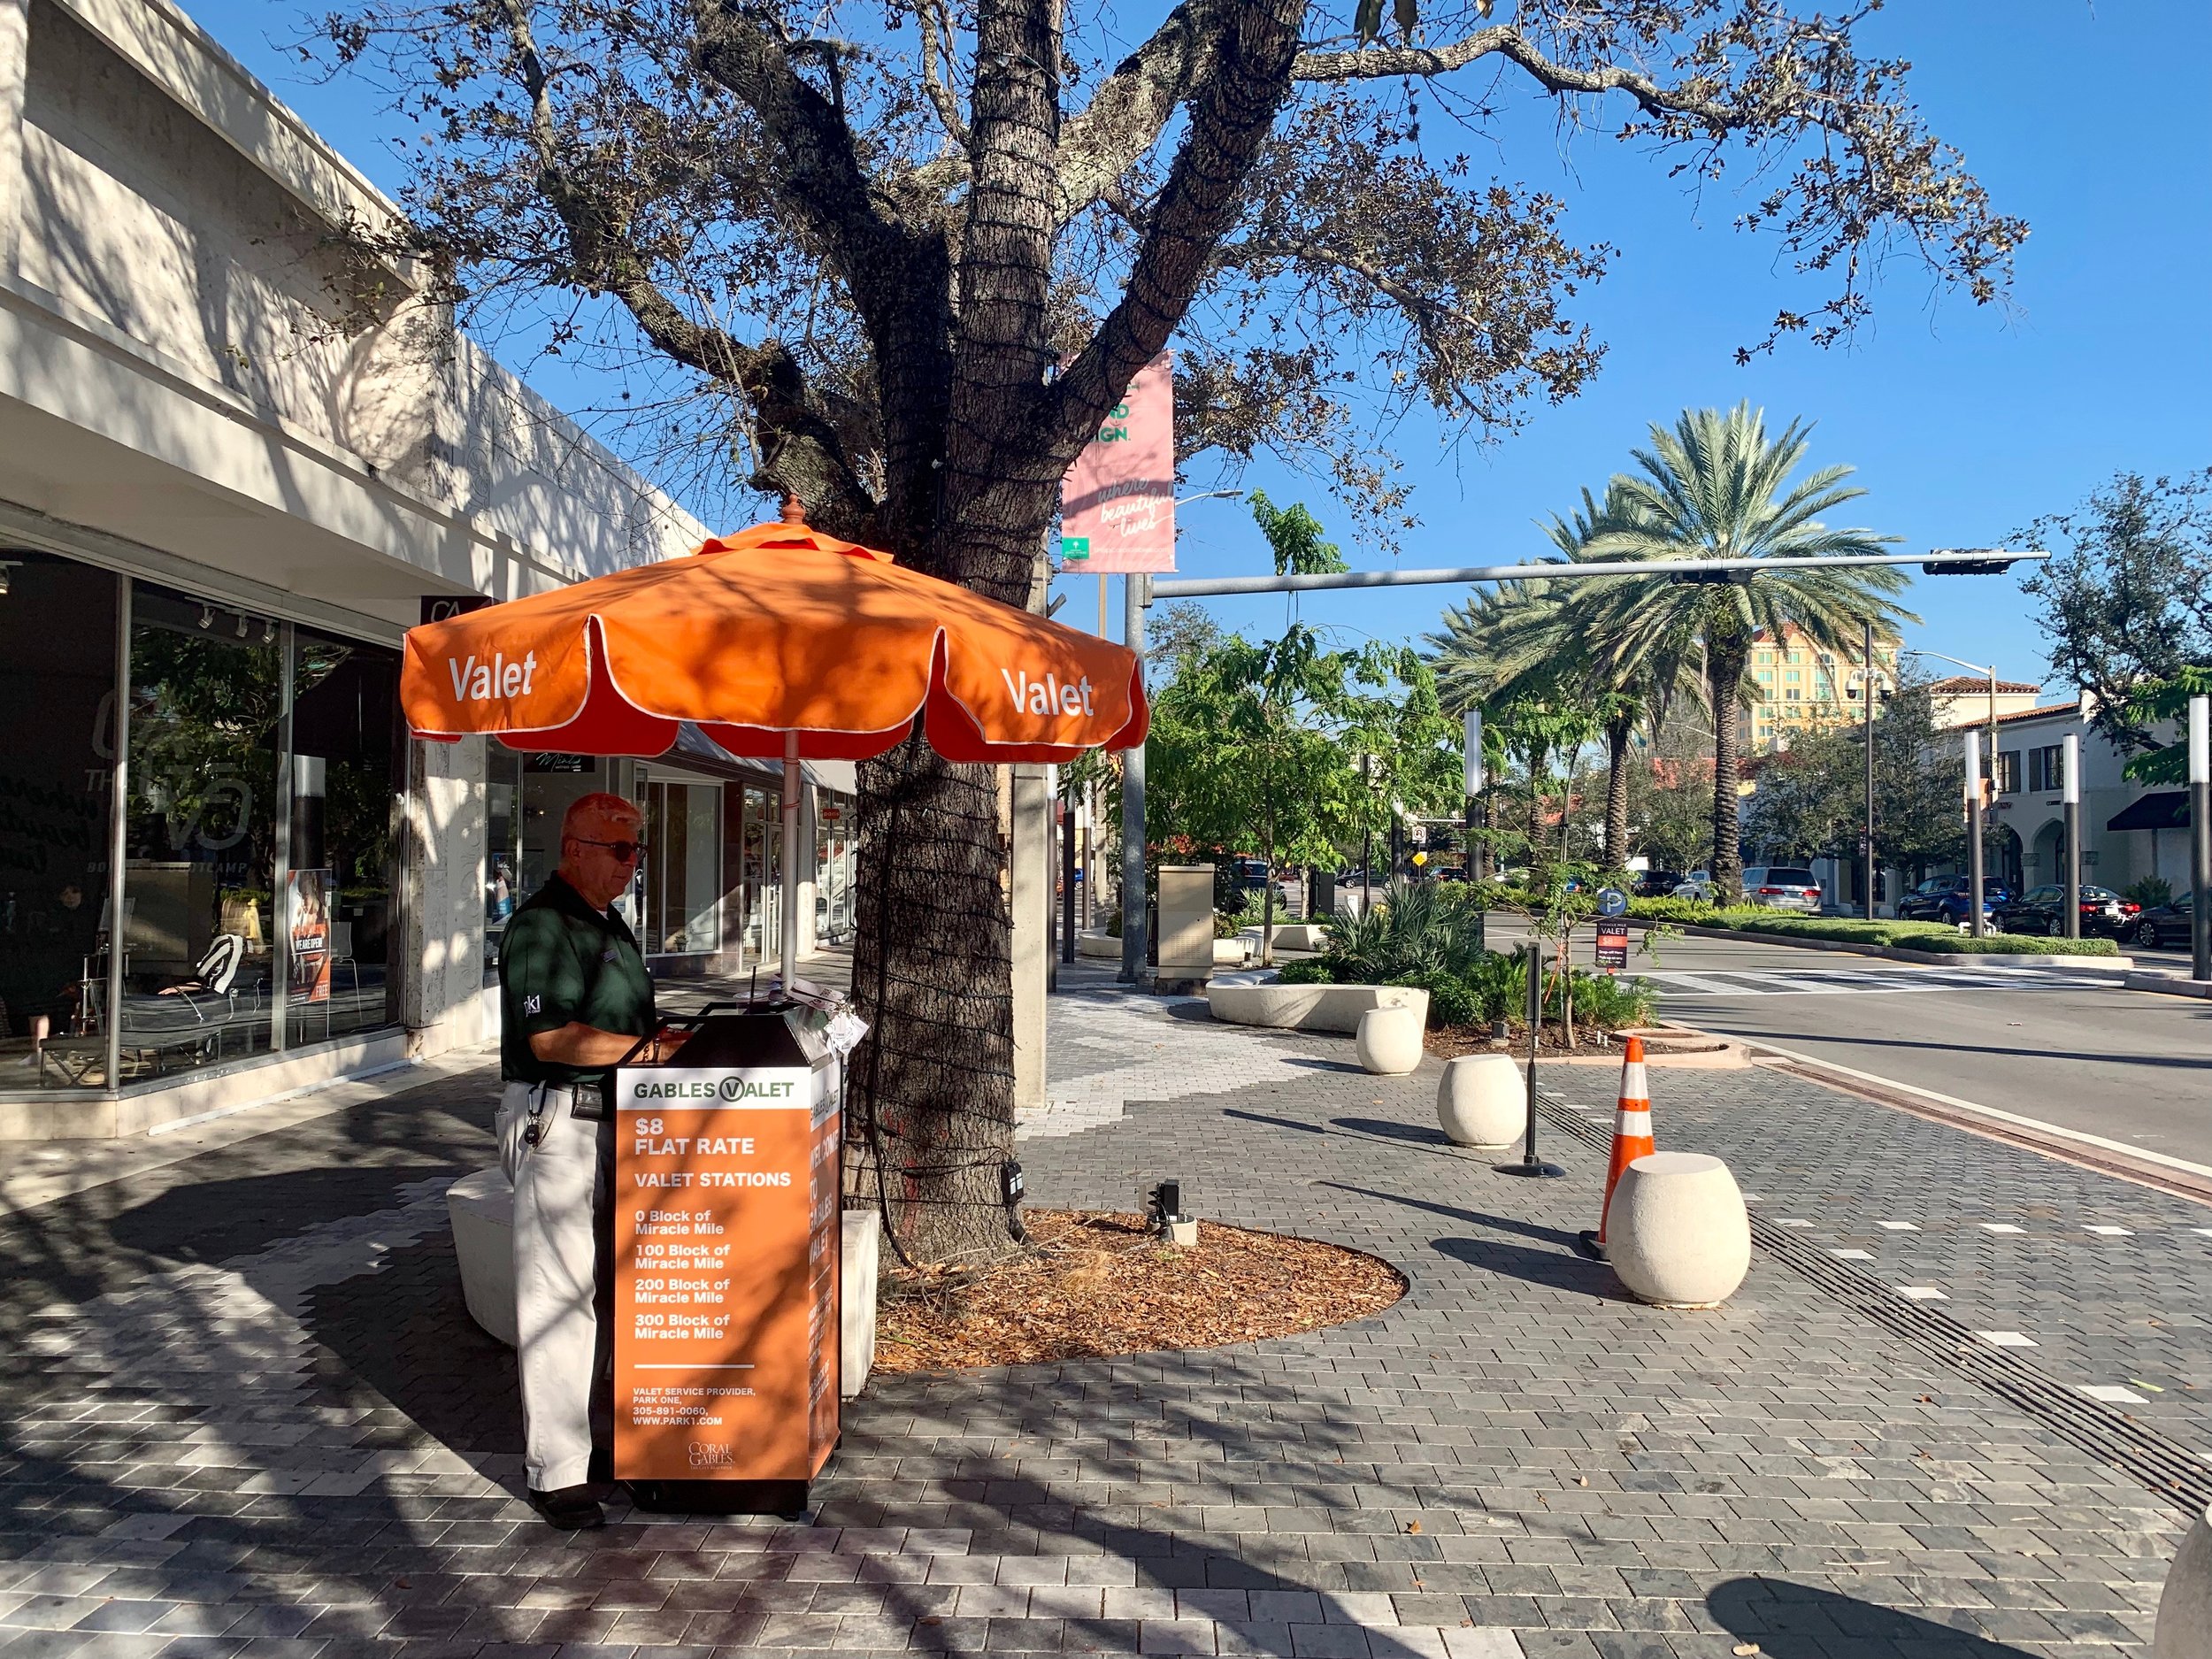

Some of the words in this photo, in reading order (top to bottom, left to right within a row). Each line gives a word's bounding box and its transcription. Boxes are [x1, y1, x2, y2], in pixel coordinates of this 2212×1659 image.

[1098, 478, 1149, 503] where
[1101, 480, 1173, 523] beautiful
[1120, 513, 1157, 537] lives
[449, 650, 537, 701] Valet
[1001, 668, 1094, 717] Valet
[1607, 893, 1622, 912] P
[1602, 937, 1613, 946] $8
[316, 984, 327, 997] FREE
[634, 1082, 716, 1098] GABLES
[719, 1077, 795, 1100] VALET
[635, 1118, 664, 1136] $8
[635, 1138, 689, 1156] FLAT
[696, 1138, 755, 1155] RATE
[810, 1127, 839, 1172] WELCOME
[634, 1173, 695, 1187] VALET
[699, 1172, 791, 1187] STATIONS
[635, 1210, 644, 1222] 0
[649, 1210, 690, 1222] Block
[695, 1210, 711, 1222] of
[635, 1223, 689, 1235] Miracle
[694, 1223, 724, 1235] Mile
[636, 1244, 664, 1256] 100
[669, 1244, 709, 1256] Block
[714, 1244, 731, 1256] of
[809, 1225, 829, 1266] VALET
[635, 1257, 689, 1270] Miracle
[694, 1257, 724, 1270] Mile
[635, 1279, 664, 1291] 200
[669, 1279, 709, 1291] Block
[714, 1279, 730, 1291] of
[634, 1292, 689, 1303] Miracle
[694, 1292, 724, 1303] Mile
[635, 1314, 664, 1326] 300
[669, 1314, 709, 1326] Block
[714, 1314, 730, 1326] of
[634, 1327, 689, 1339] Miracle
[694, 1327, 724, 1339] Mile
[707, 1387, 756, 1396] PROVIDER,
[661, 1396, 682, 1405] ONE,
[634, 1407, 708, 1416] 305-891-0060,
[688, 1442, 732, 1455] CORAL
[688, 1454, 733, 1466] GABLES
